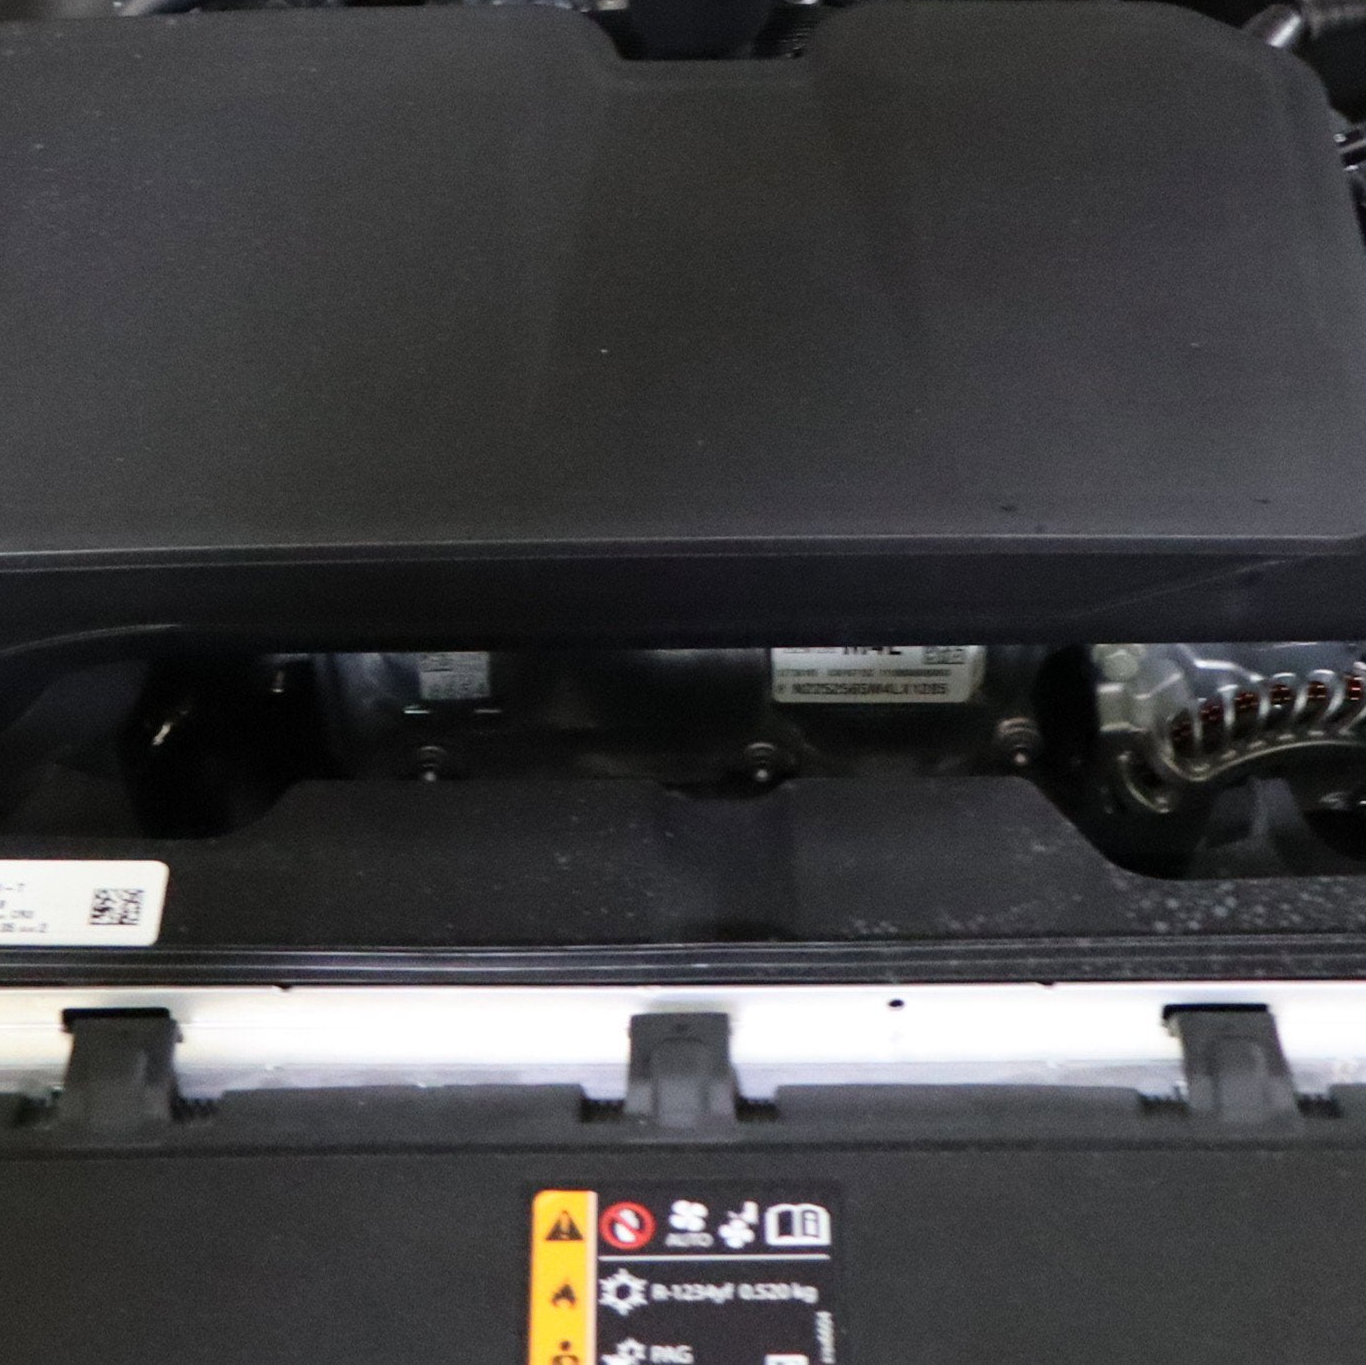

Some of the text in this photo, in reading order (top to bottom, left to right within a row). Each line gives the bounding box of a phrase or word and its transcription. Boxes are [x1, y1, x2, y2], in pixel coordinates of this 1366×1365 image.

[665, 1232, 714, 1248] AUTO
[737, 1283, 791, 1300] 0.520
[791, 1282, 819, 1304] kg
[650, 1345, 695, 1364] PAG
